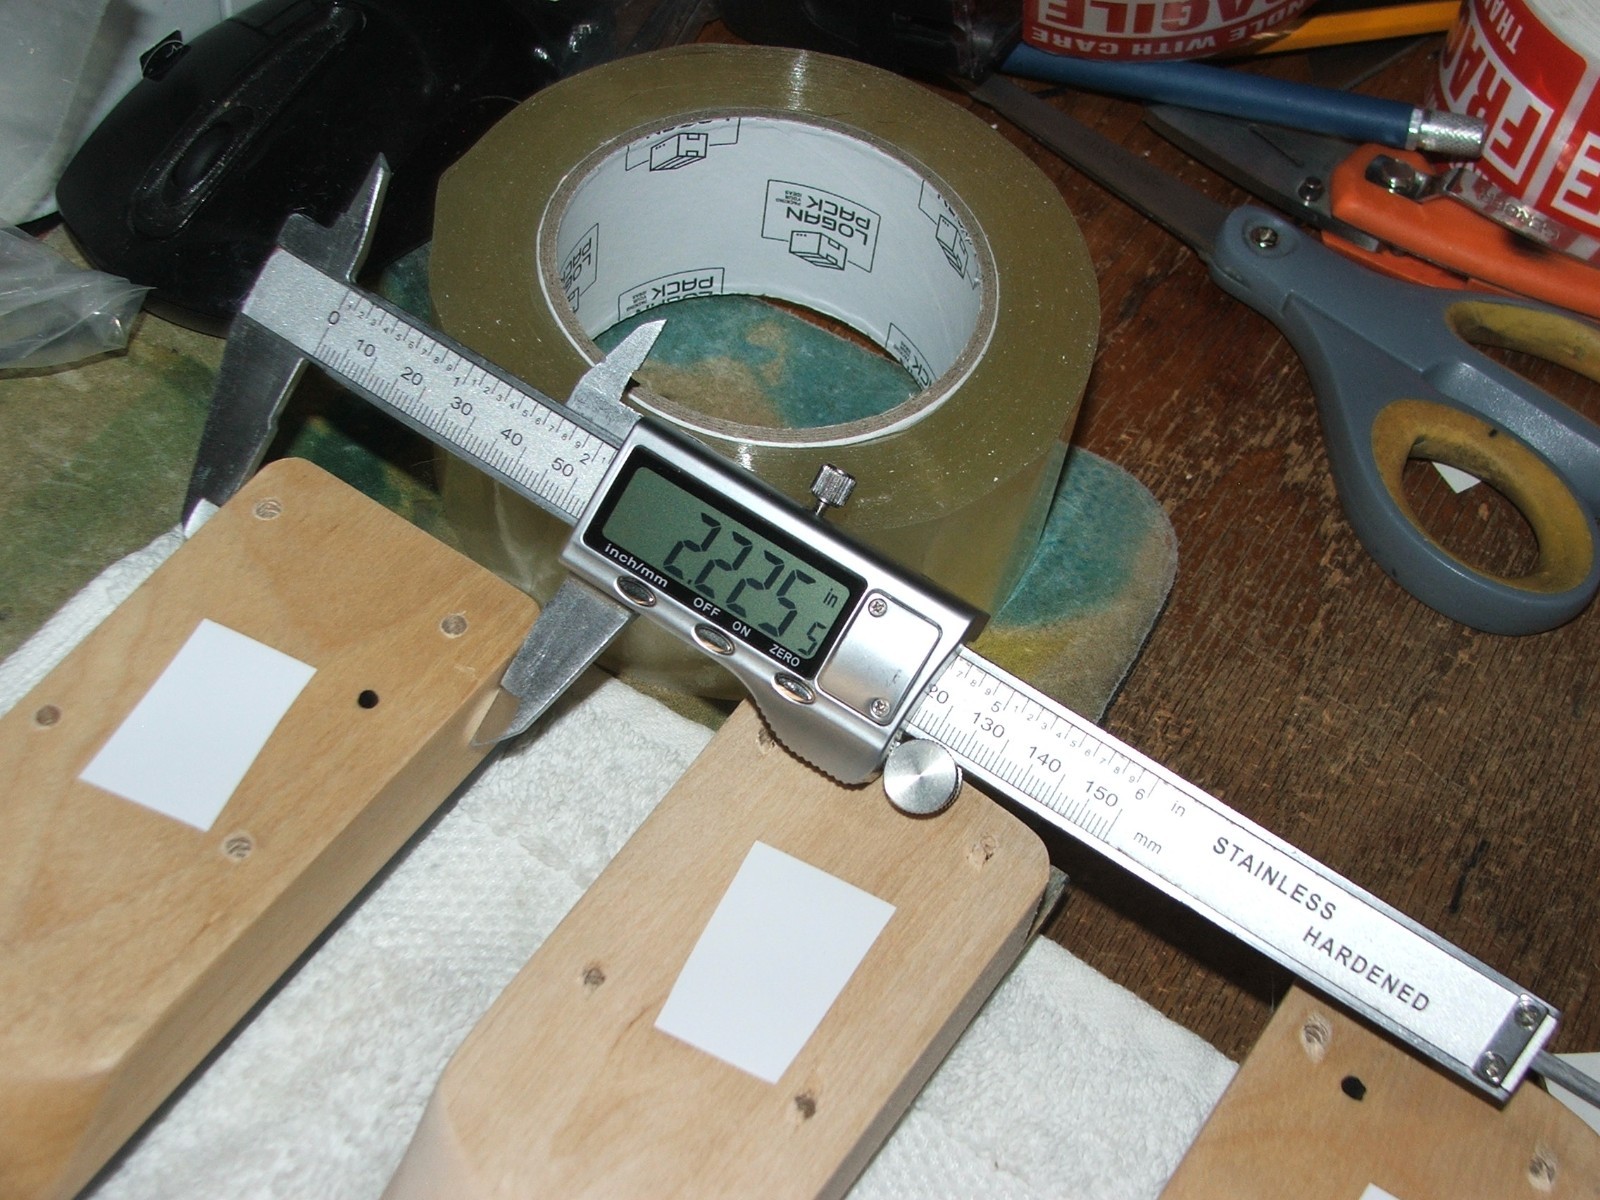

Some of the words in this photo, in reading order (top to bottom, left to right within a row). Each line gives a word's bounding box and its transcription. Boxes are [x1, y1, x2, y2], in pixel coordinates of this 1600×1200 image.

[1031, 26, 1119, 55] CARE
[1132, 35, 1215, 56] WITH
[786, 207, 868, 246] LOGAN
[806, 195, 871, 231] PACK
[651, 276, 714, 301] PACK
[327, 310, 340, 325] 0
[357, 339, 376, 357] 10
[400, 366, 423, 386] 20
[450, 396, 473, 416] 30
[500, 428, 523, 447] 40
[551, 457, 574, 477] 50
[453, 376, 460, 387] 1
[580, 453, 591, 465] 2
[604, 543, 669, 588] inch/mm
[693, 596, 722, 618] OFF
[732, 620, 752, 638] ON
[823, 587, 839, 610] in
[769, 643, 801, 668] ZERO
[990, 700, 1002, 713] 5
[1135, 788, 1146, 800] 6
[1170, 801, 1187, 817] in
[972, 711, 1005, 739] 130
[1028, 746, 1062, 774] 140
[1085, 780, 1119, 807] 150
[1133, 831, 1162, 855] mm
[1212, 836, 1337, 920] STAINLESS
[1302, 925, 1431, 1013] HARDENED
